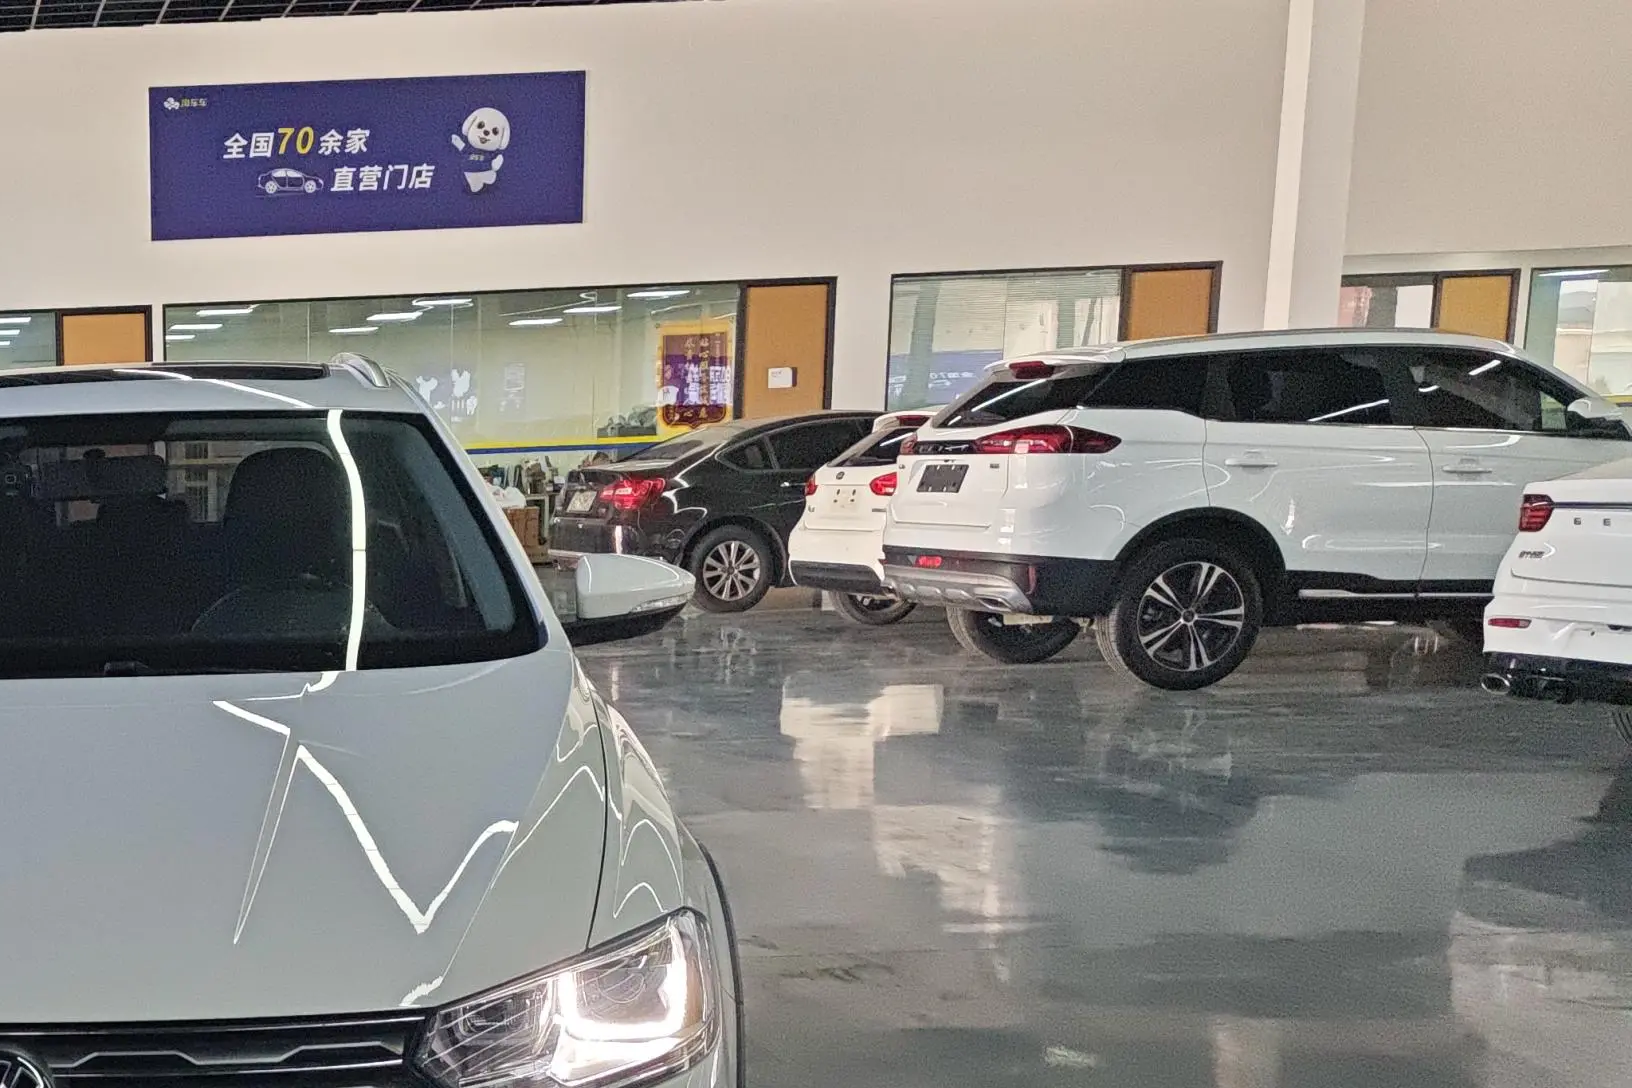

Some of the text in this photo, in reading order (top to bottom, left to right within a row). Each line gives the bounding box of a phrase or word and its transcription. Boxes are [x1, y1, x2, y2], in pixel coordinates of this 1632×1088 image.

[222, 126, 371, 159] 全国70余家
[330, 163, 436, 192] 直营门店
